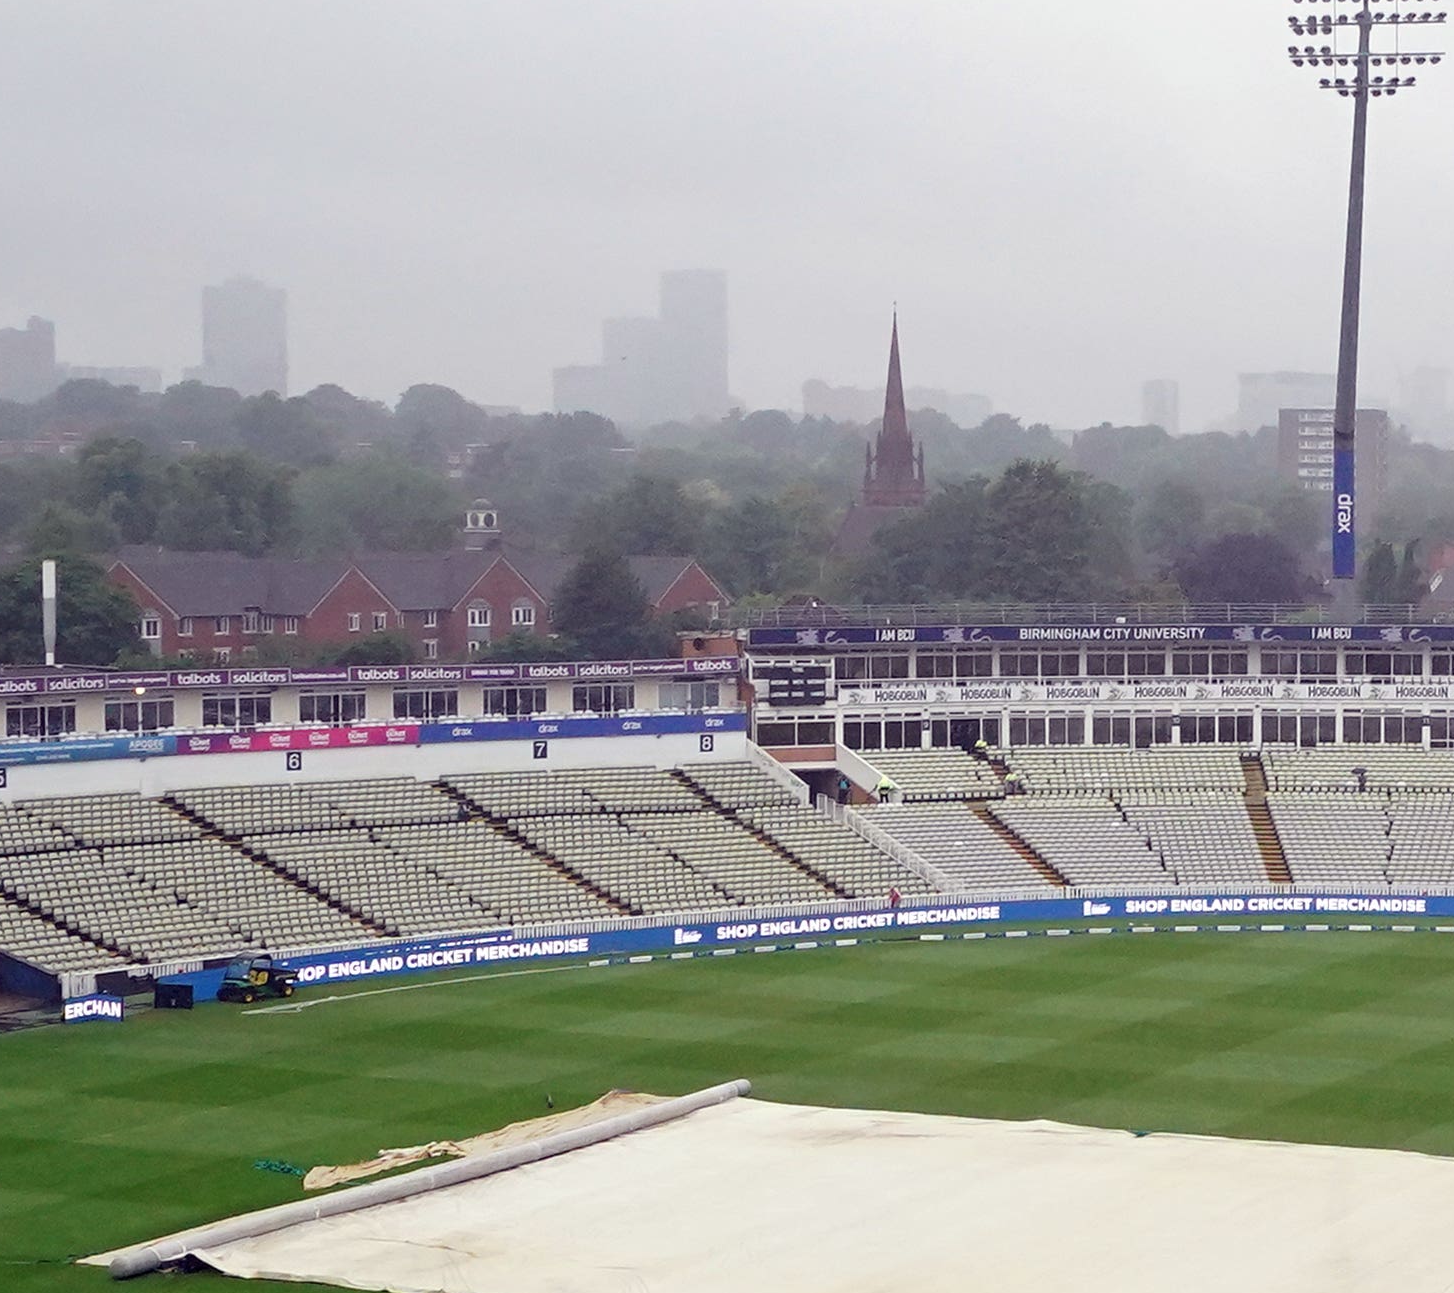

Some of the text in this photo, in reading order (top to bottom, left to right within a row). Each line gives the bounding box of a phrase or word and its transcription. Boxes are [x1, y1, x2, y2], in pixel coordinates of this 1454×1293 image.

[1337, 493, 1353, 533] drax
[880, 629, 895, 641] AM
[897, 629, 915, 641] BCU
[1020, 627, 1205, 640] BIRMINGHAM CITY UNIVERSITY
[178, 670, 286, 685] talbots solicitors
[529, 665, 569, 678] talbots
[50, 677, 104, 691] solicitors
[1047, 687, 1099, 699] HOBGOBLIN
[1221, 685, 1273, 697] HOBGOBLIN
[538, 723, 558, 734] drax
[705, 718, 725, 728] drax
[452, 727, 473, 737] drax
[130, 740, 163, 750] APOGEE
[536, 743, 545, 757] 7
[702, 737, 712, 750] 8
[289, 754, 299, 769] 6
[717, 925, 757, 940] SHOP
[760, 918, 830, 937] ENGLAND
[834, 913, 894, 931] CRICKET
[898, 906, 999, 925] MERCHANDISE
[286, 938, 589, 984] HOP ENGLAND CRICKET MERCHANDISE
[65, 997, 122, 1021] ERCHAN
